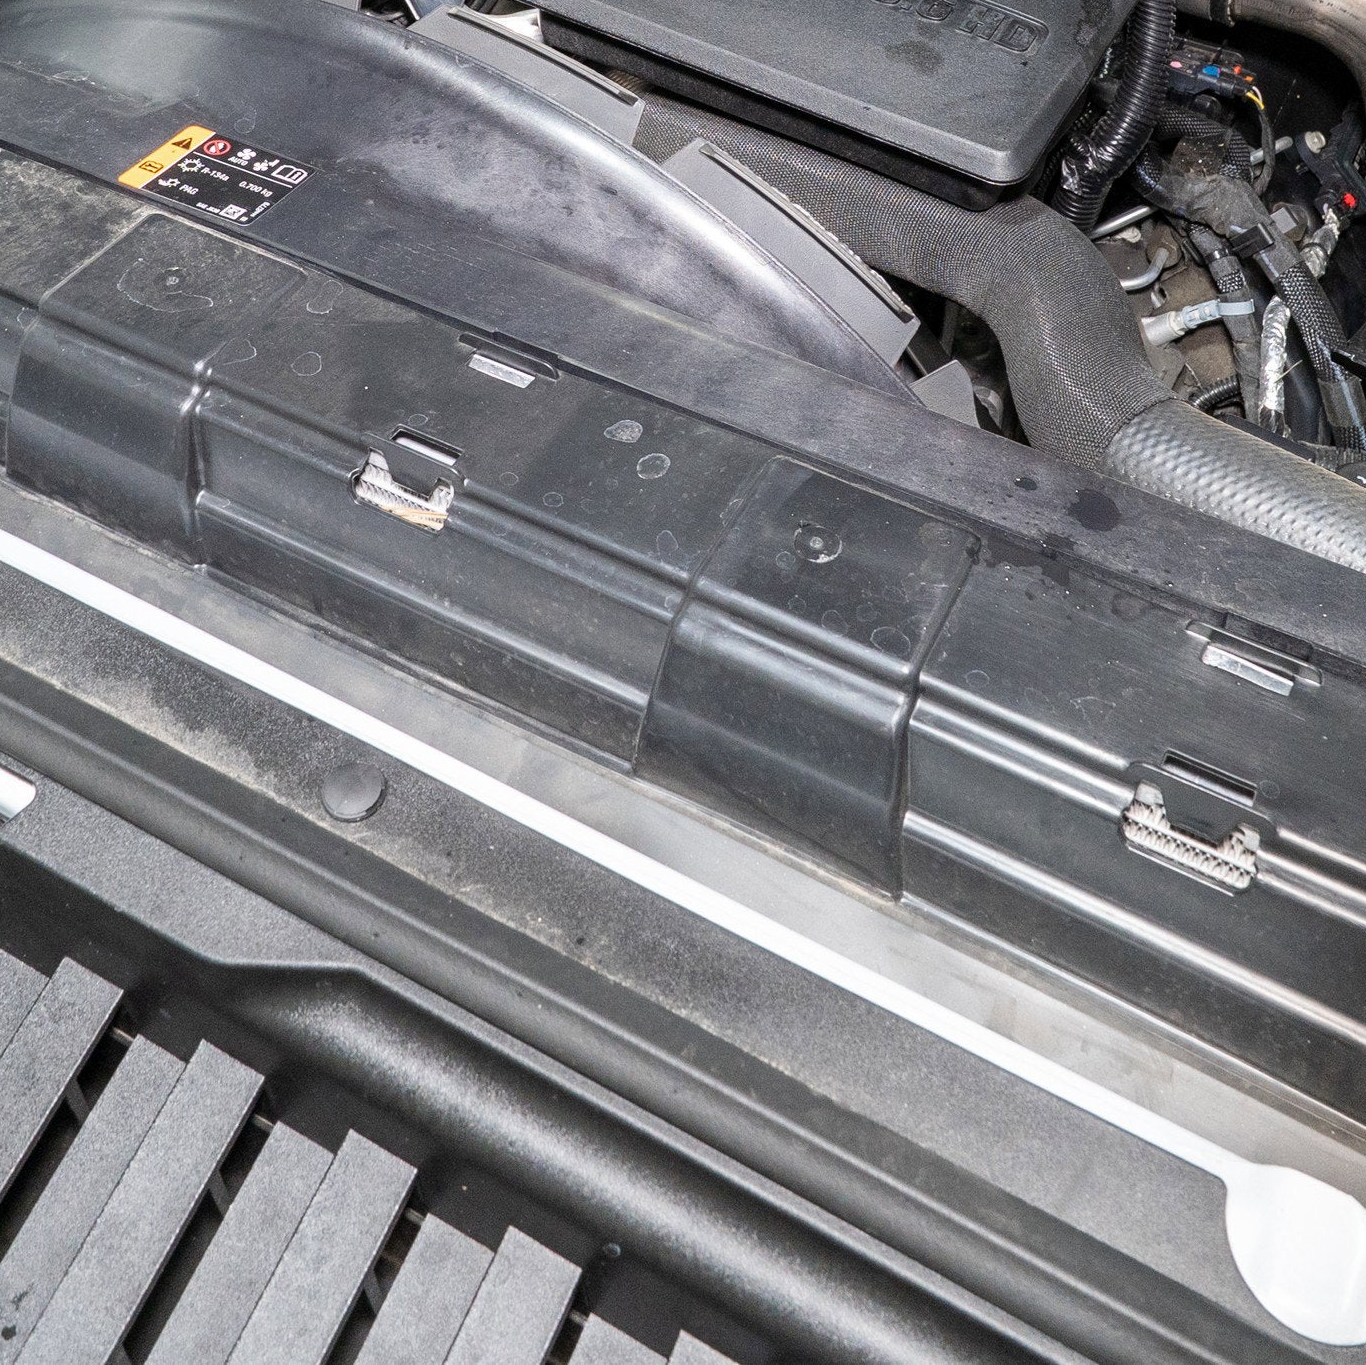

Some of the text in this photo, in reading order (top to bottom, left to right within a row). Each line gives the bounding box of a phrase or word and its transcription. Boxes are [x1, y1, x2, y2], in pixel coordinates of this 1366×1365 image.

[955, 5, 1041, 53] HD
[228, 156, 248, 166] AUTO
[179, 184, 198, 195] PAG
[201, 167, 272, 198] R-134a 0.700 kg
